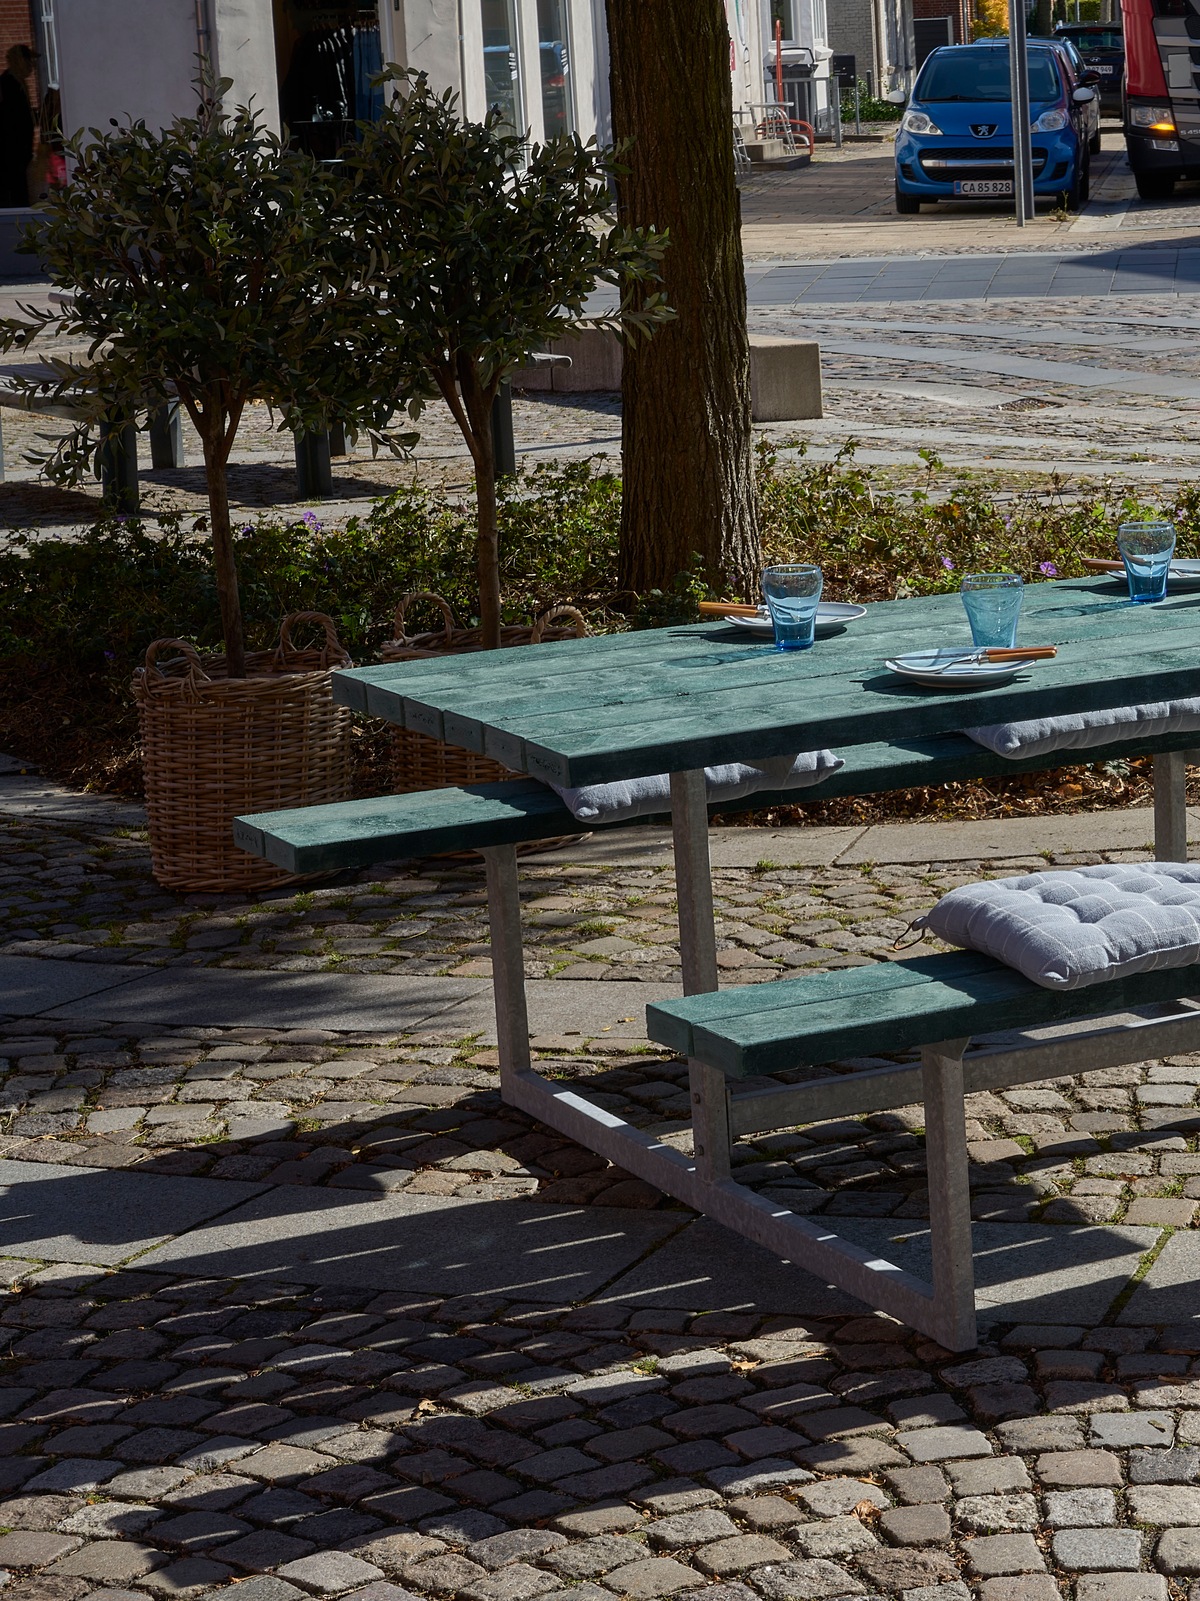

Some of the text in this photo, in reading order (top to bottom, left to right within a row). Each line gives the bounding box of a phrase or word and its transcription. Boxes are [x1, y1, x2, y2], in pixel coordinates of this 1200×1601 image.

[962, 182, 1011, 193] CA 85 828
